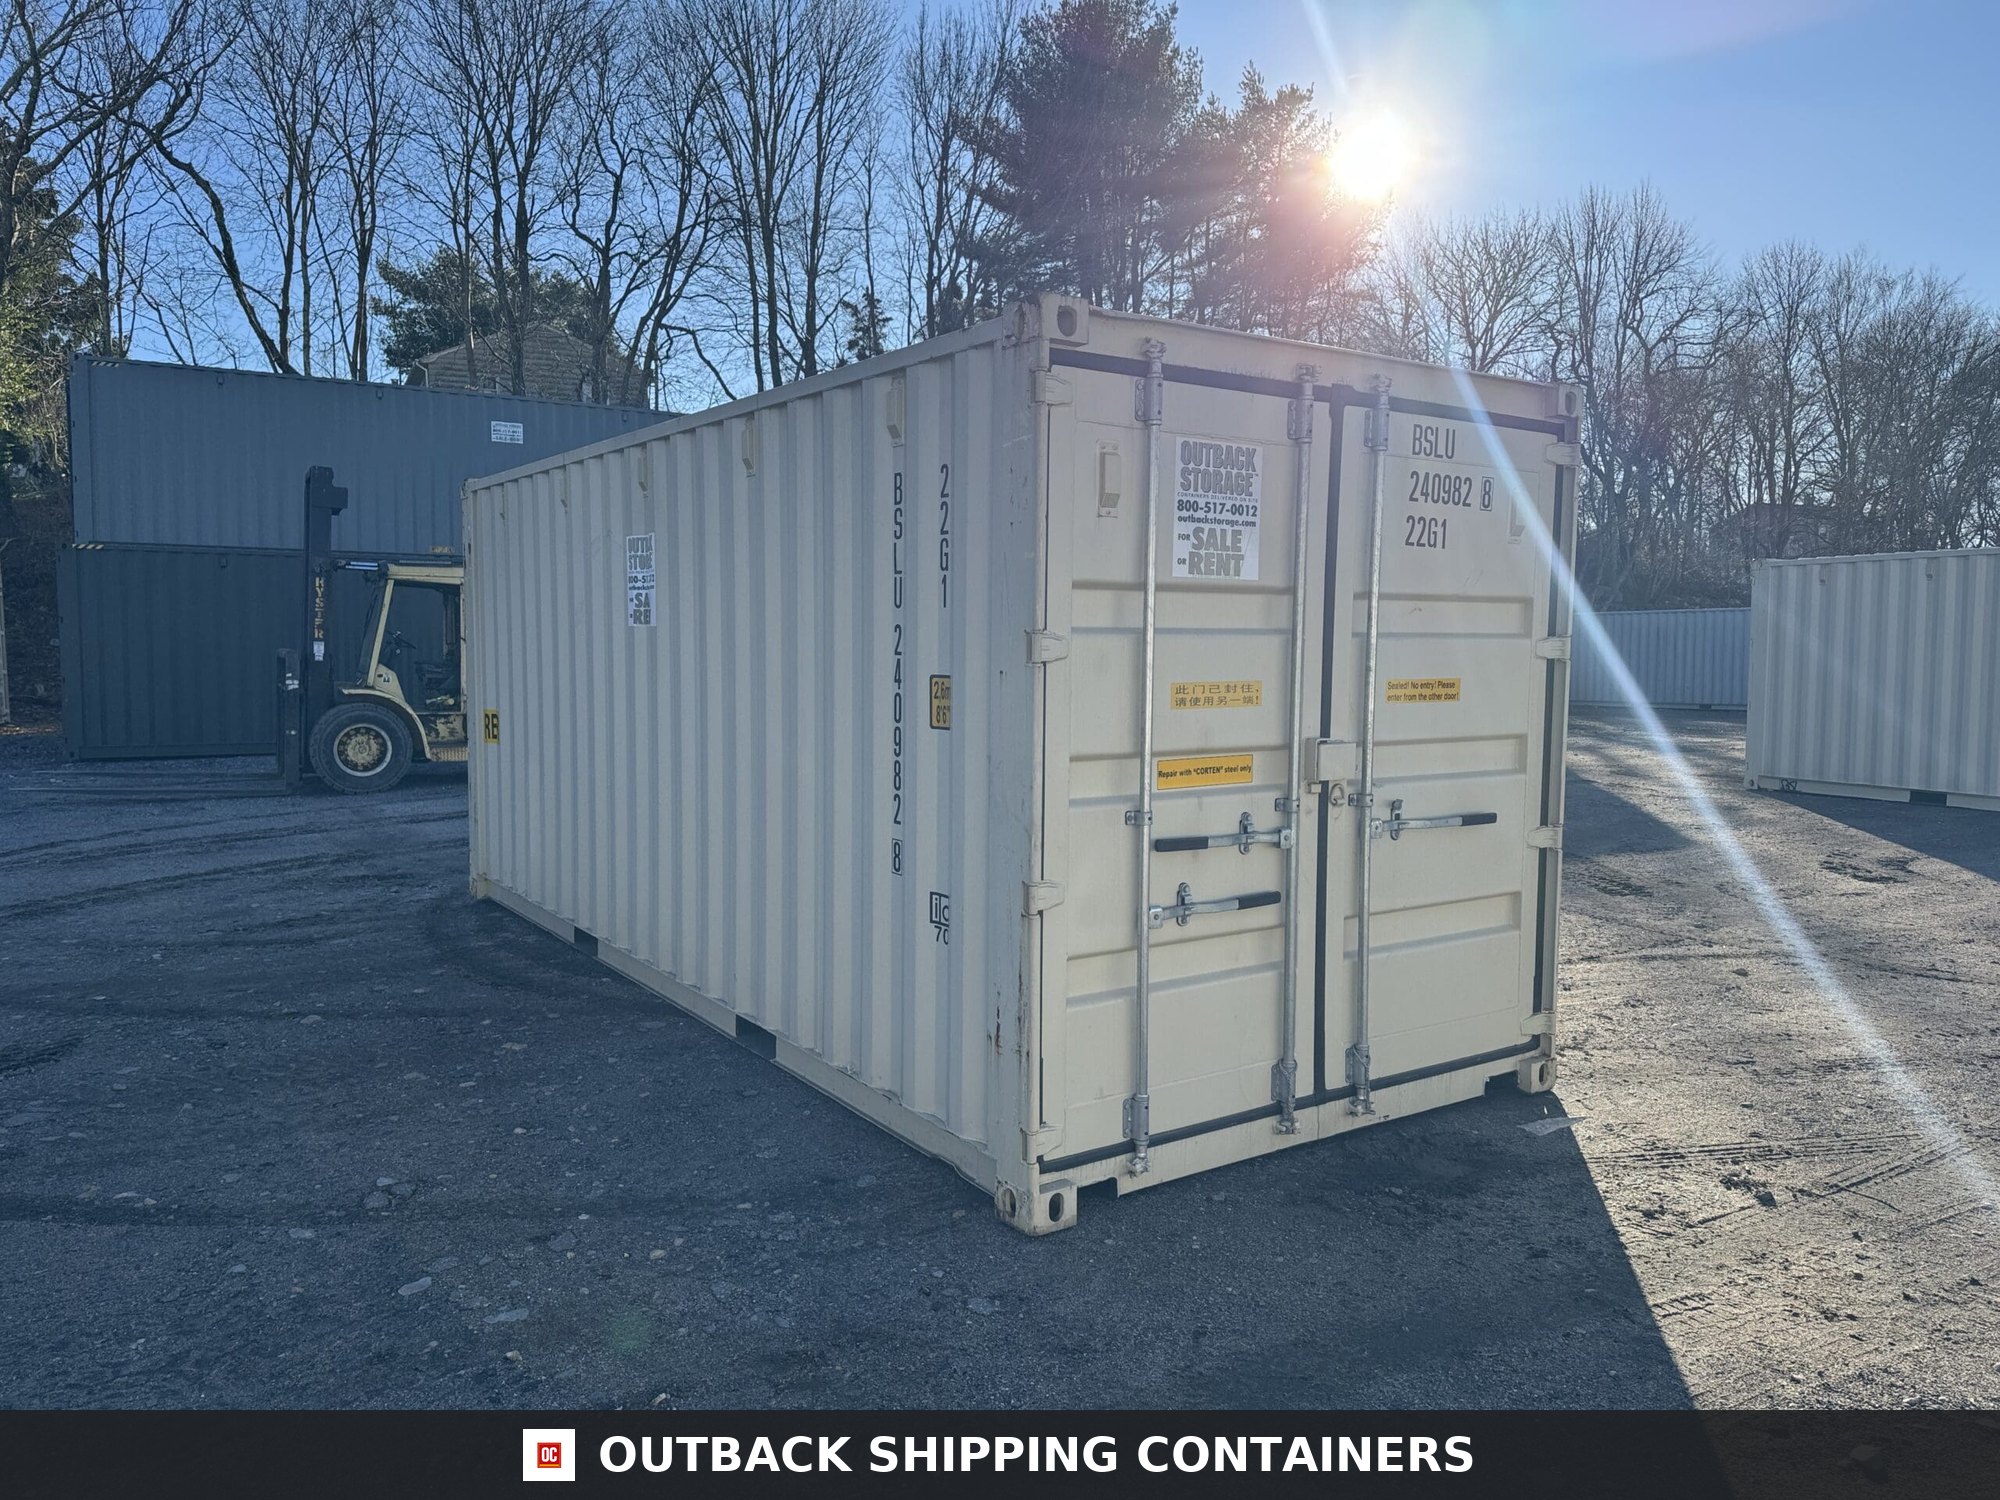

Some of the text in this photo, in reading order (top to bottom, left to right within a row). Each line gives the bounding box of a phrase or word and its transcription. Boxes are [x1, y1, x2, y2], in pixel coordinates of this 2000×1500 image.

[1180, 440, 1257, 472] OUTBACK
[1412, 424, 1456, 460] BSLU
[1177, 491, 1209, 500] CONTAINERS
[1211, 494, 1238, 502] DELIVERED
[1180, 466, 1254, 498] STORAGE
[1409, 470, 1473, 507] 240982
[1177, 499, 1258, 517] 800-517-0012
[1177, 514, 1257, 528] outbackstorage.com
[894, 472, 903, 608] BSLU
[940, 463, 950, 608] 22G1
[1178, 526, 1242, 552] FOR SALE
[1405, 514, 1447, 549] 22G1
[1188, 551, 1245, 577] RENT
[1387, 680, 1456, 691] Sealed! No entry! Please
[1387, 692, 1459, 702] enter from the other door!
[893, 623, 902, 825] 240982
[1158, 769, 1178, 780] Repair
[1179, 768, 1192, 777] with
[1225, 764, 1239, 773] steel
[1240, 764, 1252, 774] only
